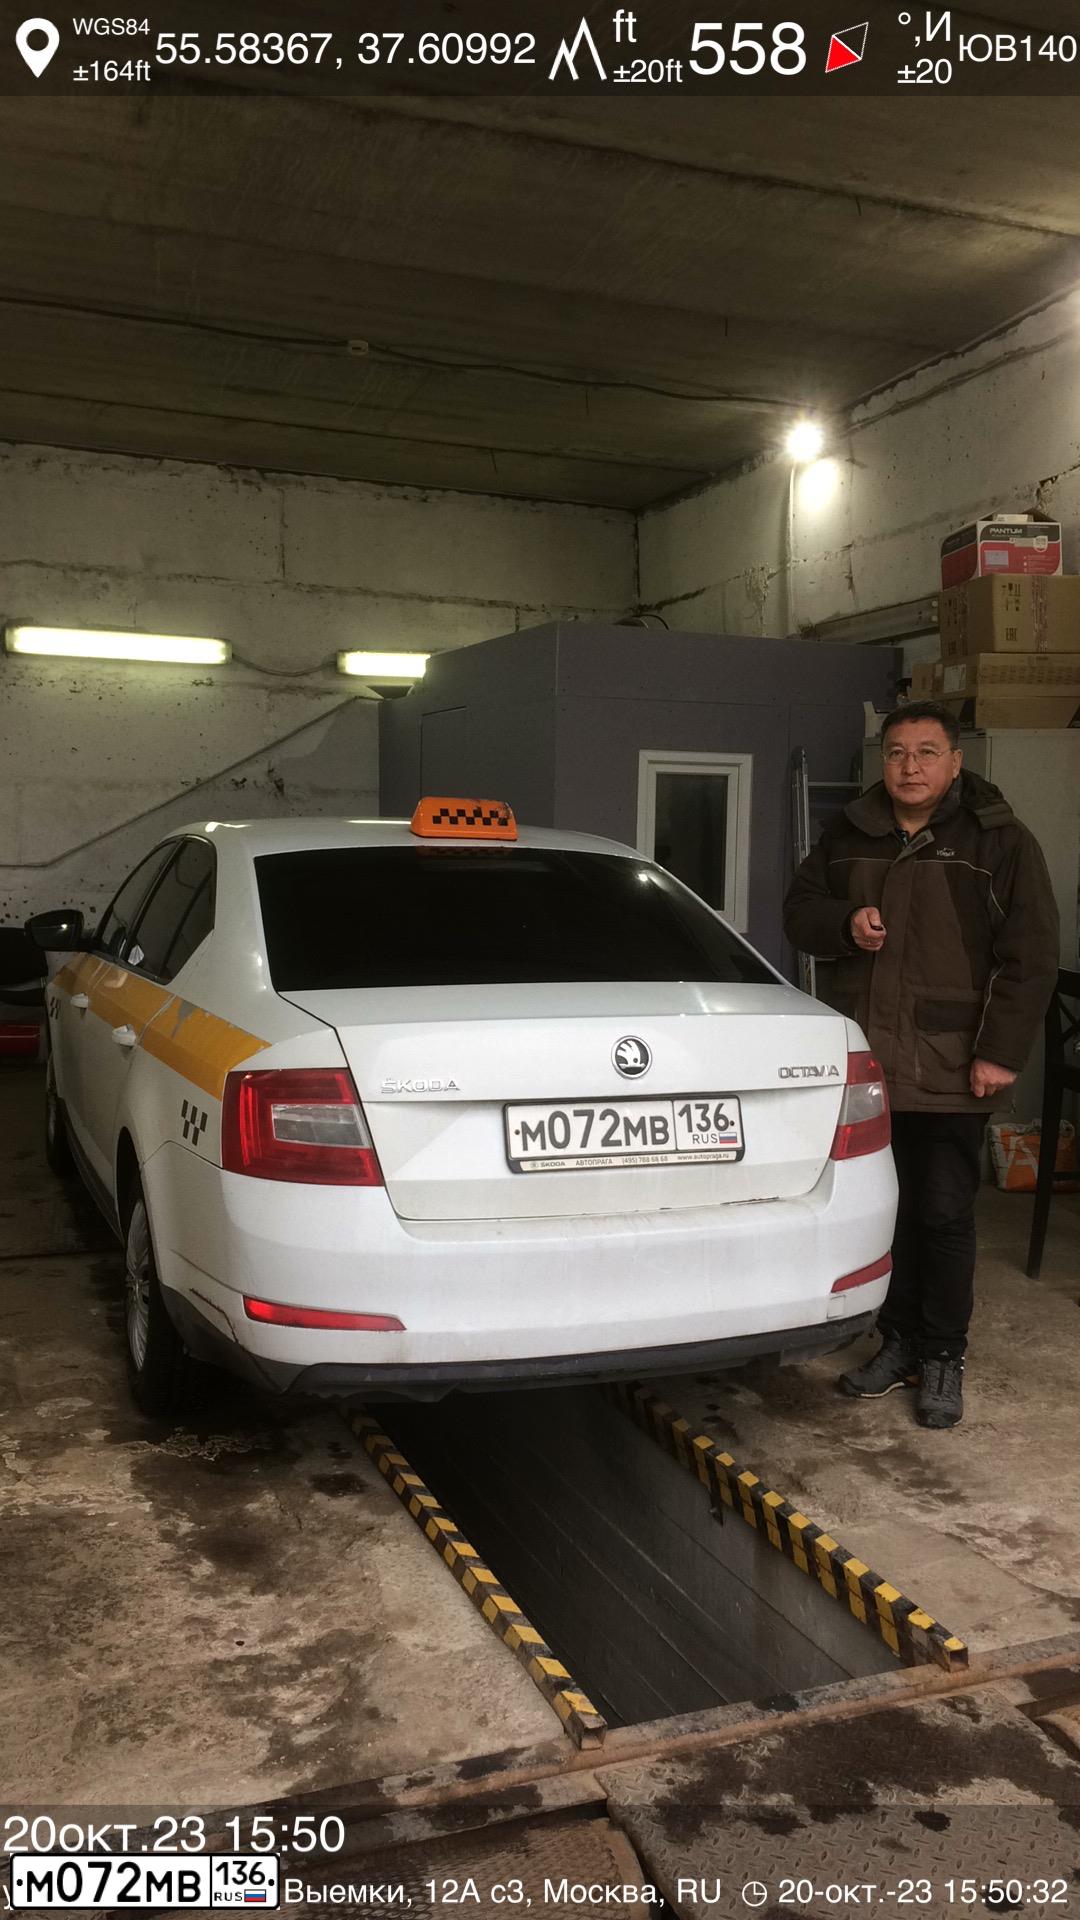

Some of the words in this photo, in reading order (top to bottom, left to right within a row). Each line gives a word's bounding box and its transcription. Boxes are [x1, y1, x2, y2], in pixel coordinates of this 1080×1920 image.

[990, 527, 1023, 535] PANTUM
[778, 1064, 840, 1079] OCTAVIA
[678, 1103, 730, 1133] 136
[692, 1133, 718, 1145] RUS
